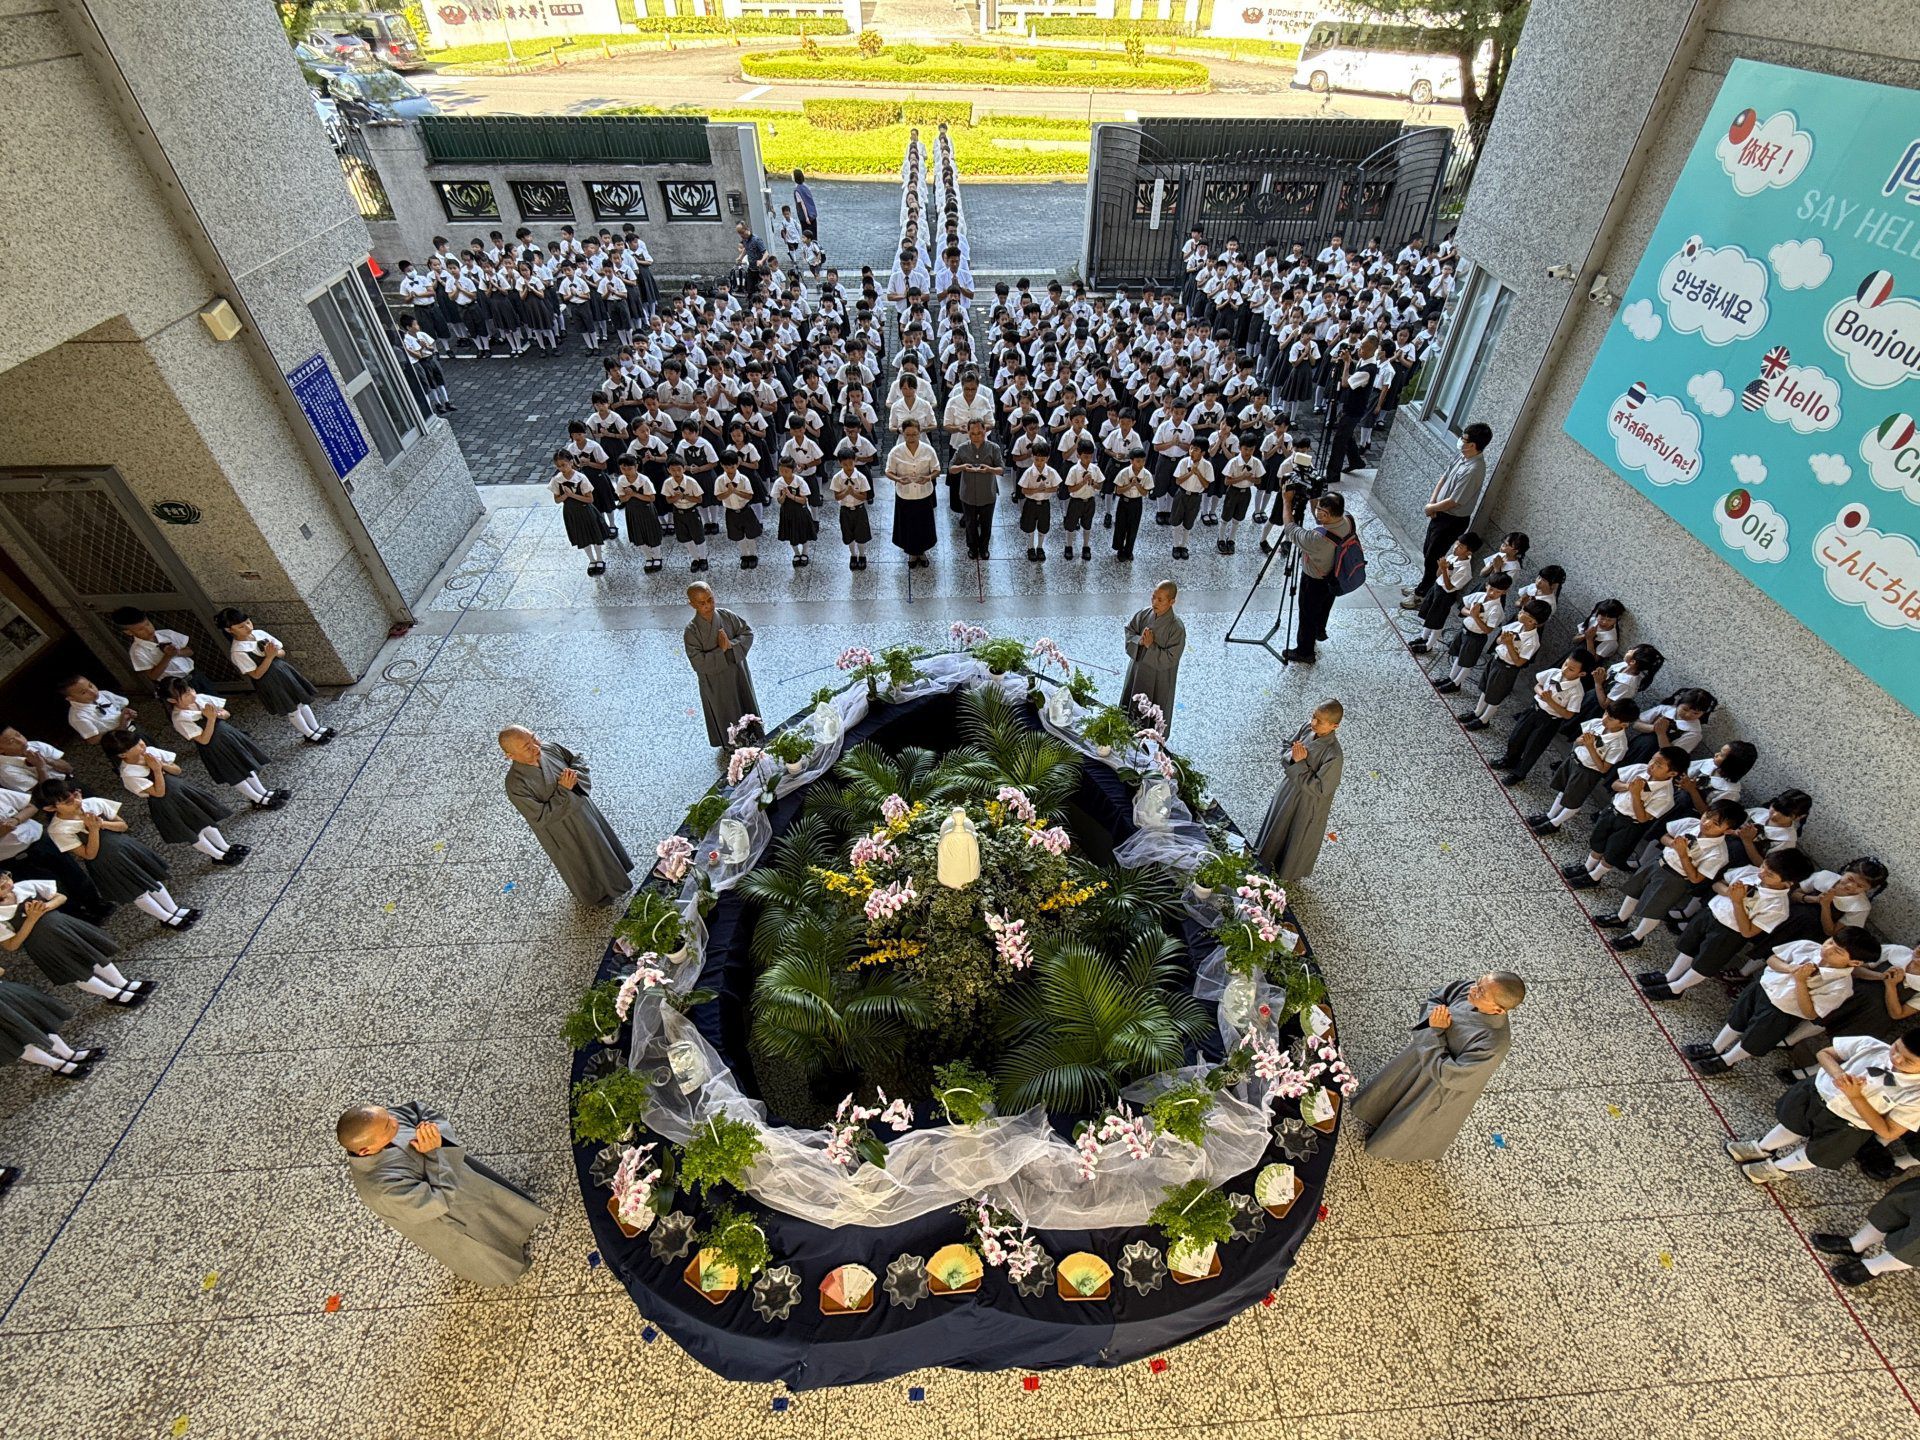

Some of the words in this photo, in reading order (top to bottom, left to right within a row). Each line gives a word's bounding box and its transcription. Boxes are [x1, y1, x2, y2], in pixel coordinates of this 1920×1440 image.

[1268, 8, 1302, 18] BUDDHIST
[1797, 190, 1859, 231] SAY
[1854, 207, 1920, 260] HEL
[1671, 269, 1752, 325] 안녕하세요
[1834, 309, 1920, 371] Bonjou
[1774, 376, 1830, 422] Hello
[1742, 514, 1777, 550] Olá
